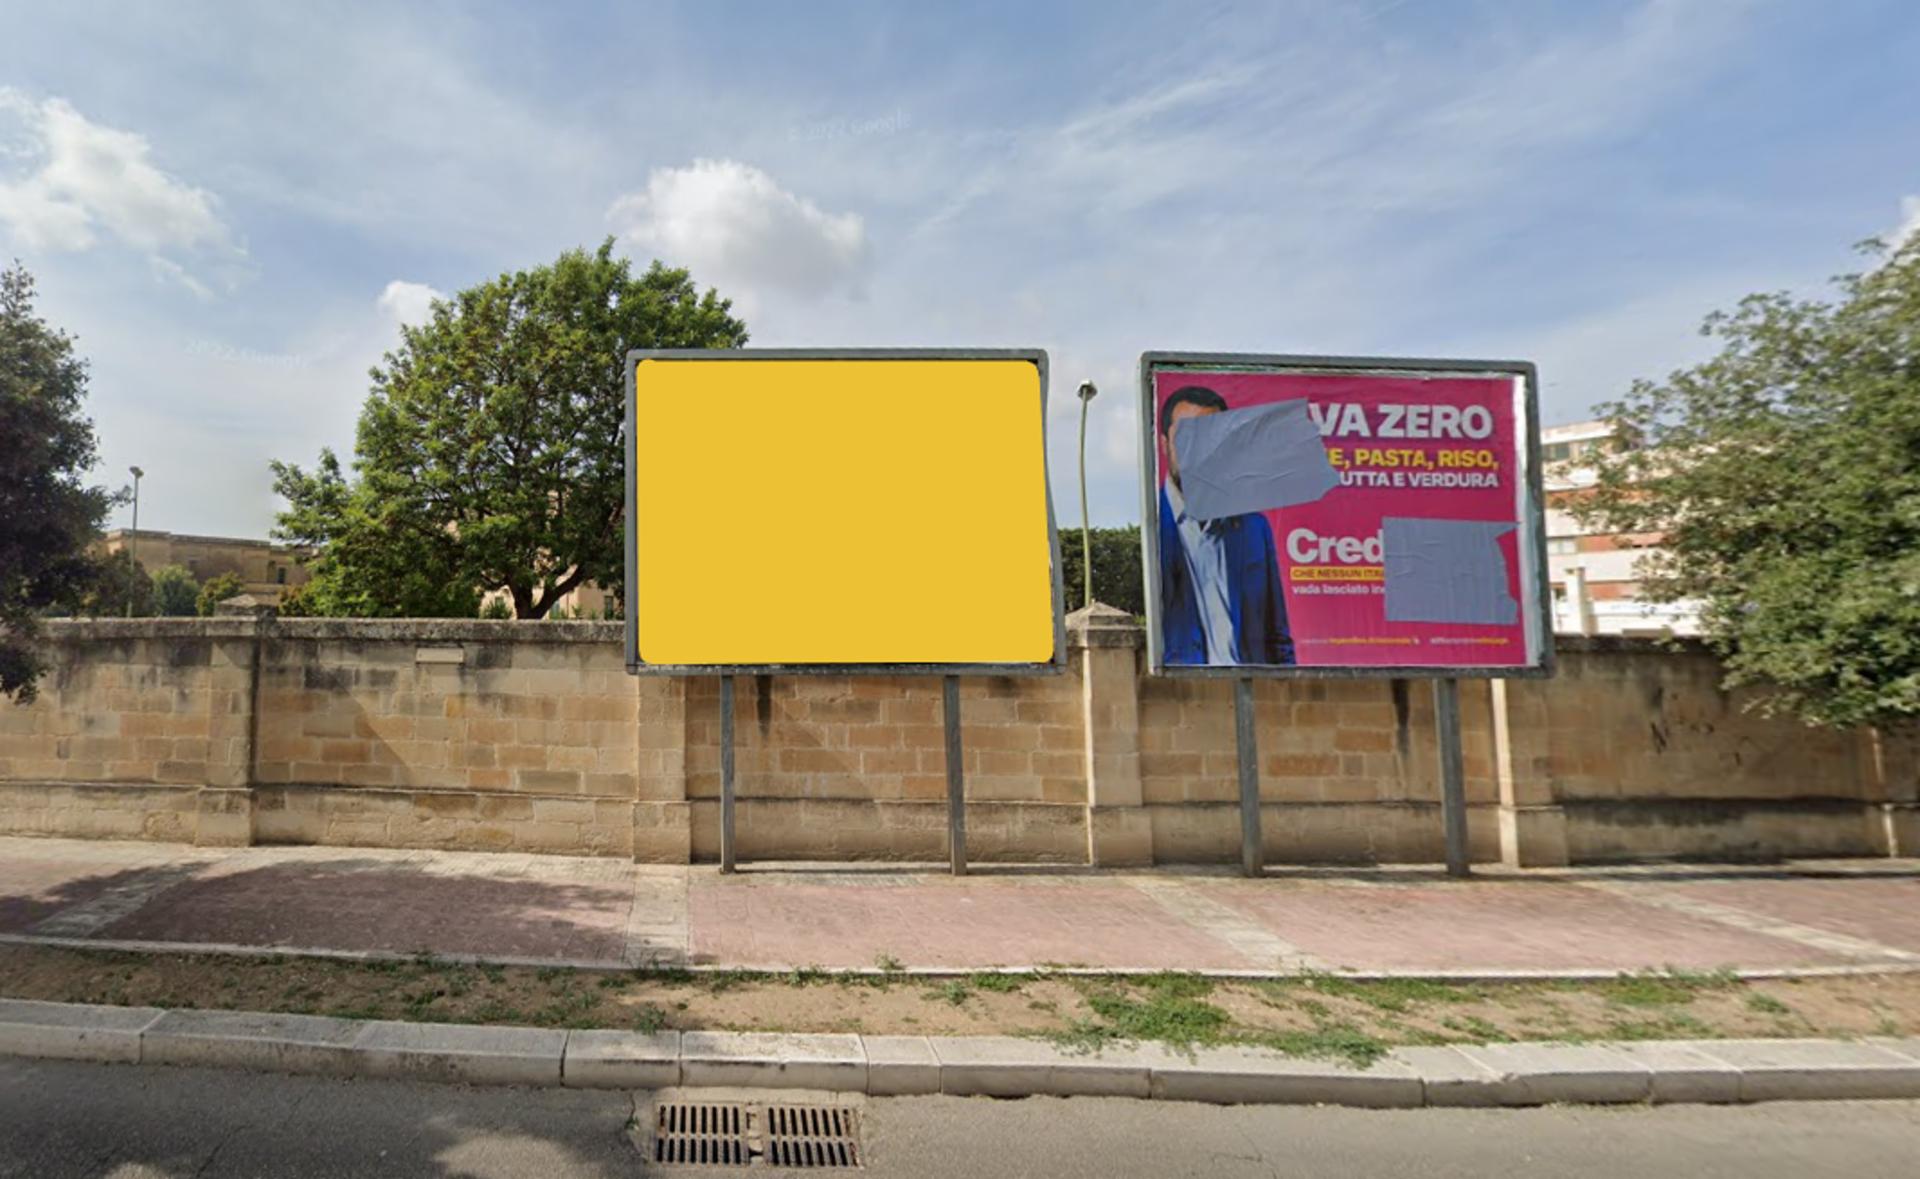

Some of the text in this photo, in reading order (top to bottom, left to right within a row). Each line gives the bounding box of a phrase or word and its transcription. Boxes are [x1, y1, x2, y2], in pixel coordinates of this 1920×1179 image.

[1377, 404, 1492, 439] ZERO
[1355, 449, 1434, 471] PASTA,
[1438, 450, 1498, 471] RISO,
[1392, 472, 1405, 487] E
[1408, 473, 1498, 487] VERDURA
[1286, 527, 1384, 563] Cred
